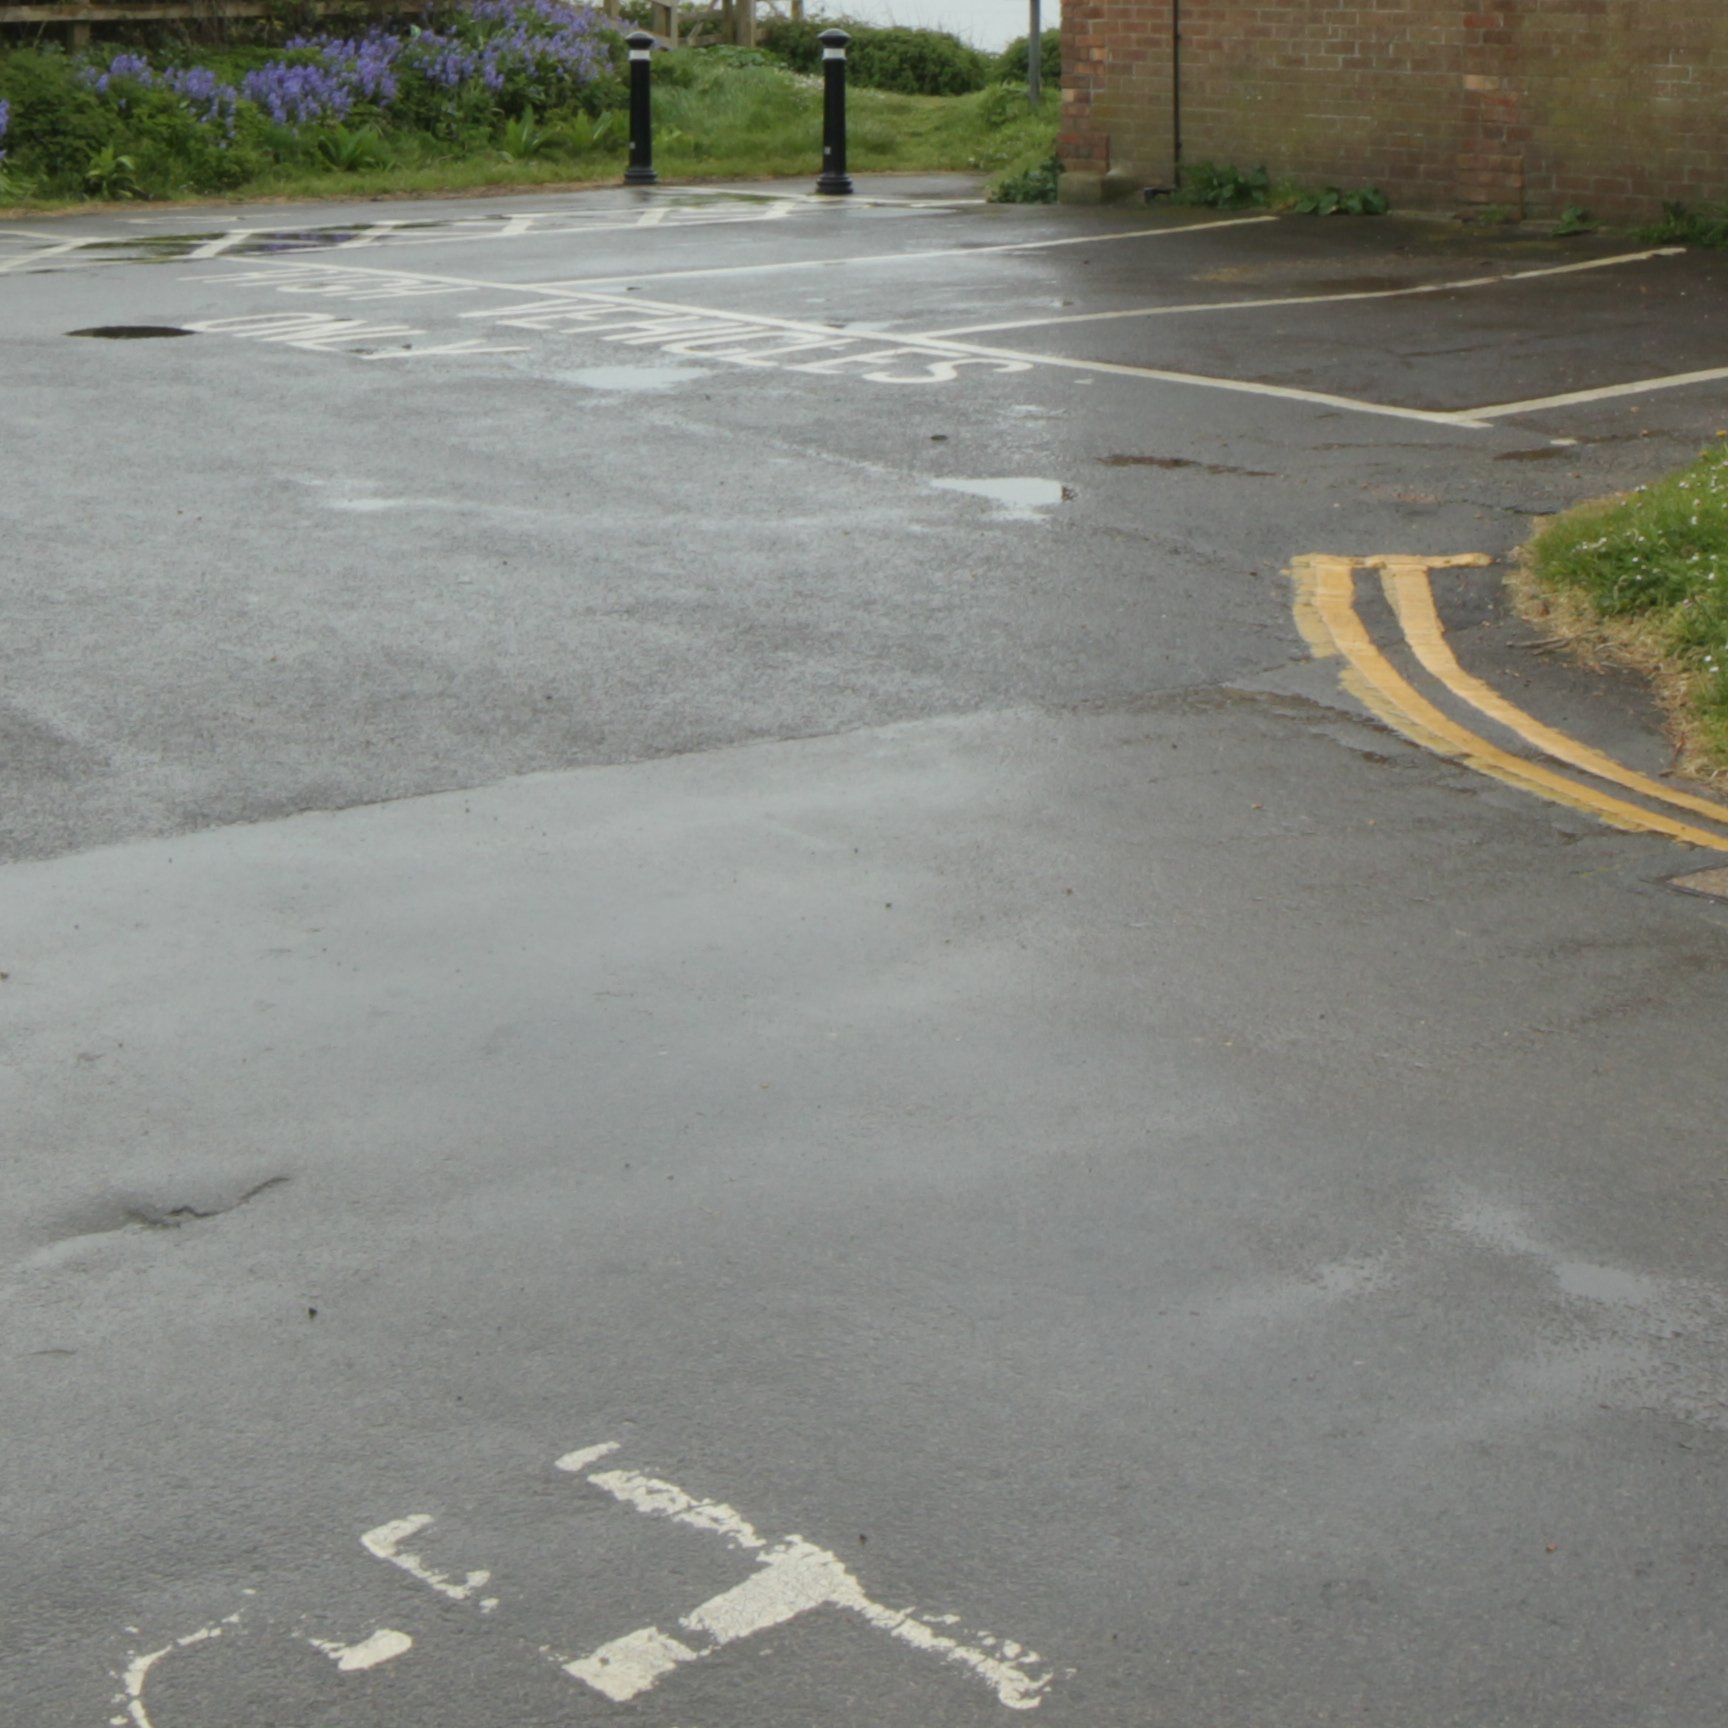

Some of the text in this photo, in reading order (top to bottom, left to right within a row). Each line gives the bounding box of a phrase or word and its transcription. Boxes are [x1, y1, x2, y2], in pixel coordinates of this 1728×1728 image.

[178, 267, 1034, 384] HIGH VEHICLES
[181, 312, 531, 360] ONLY
